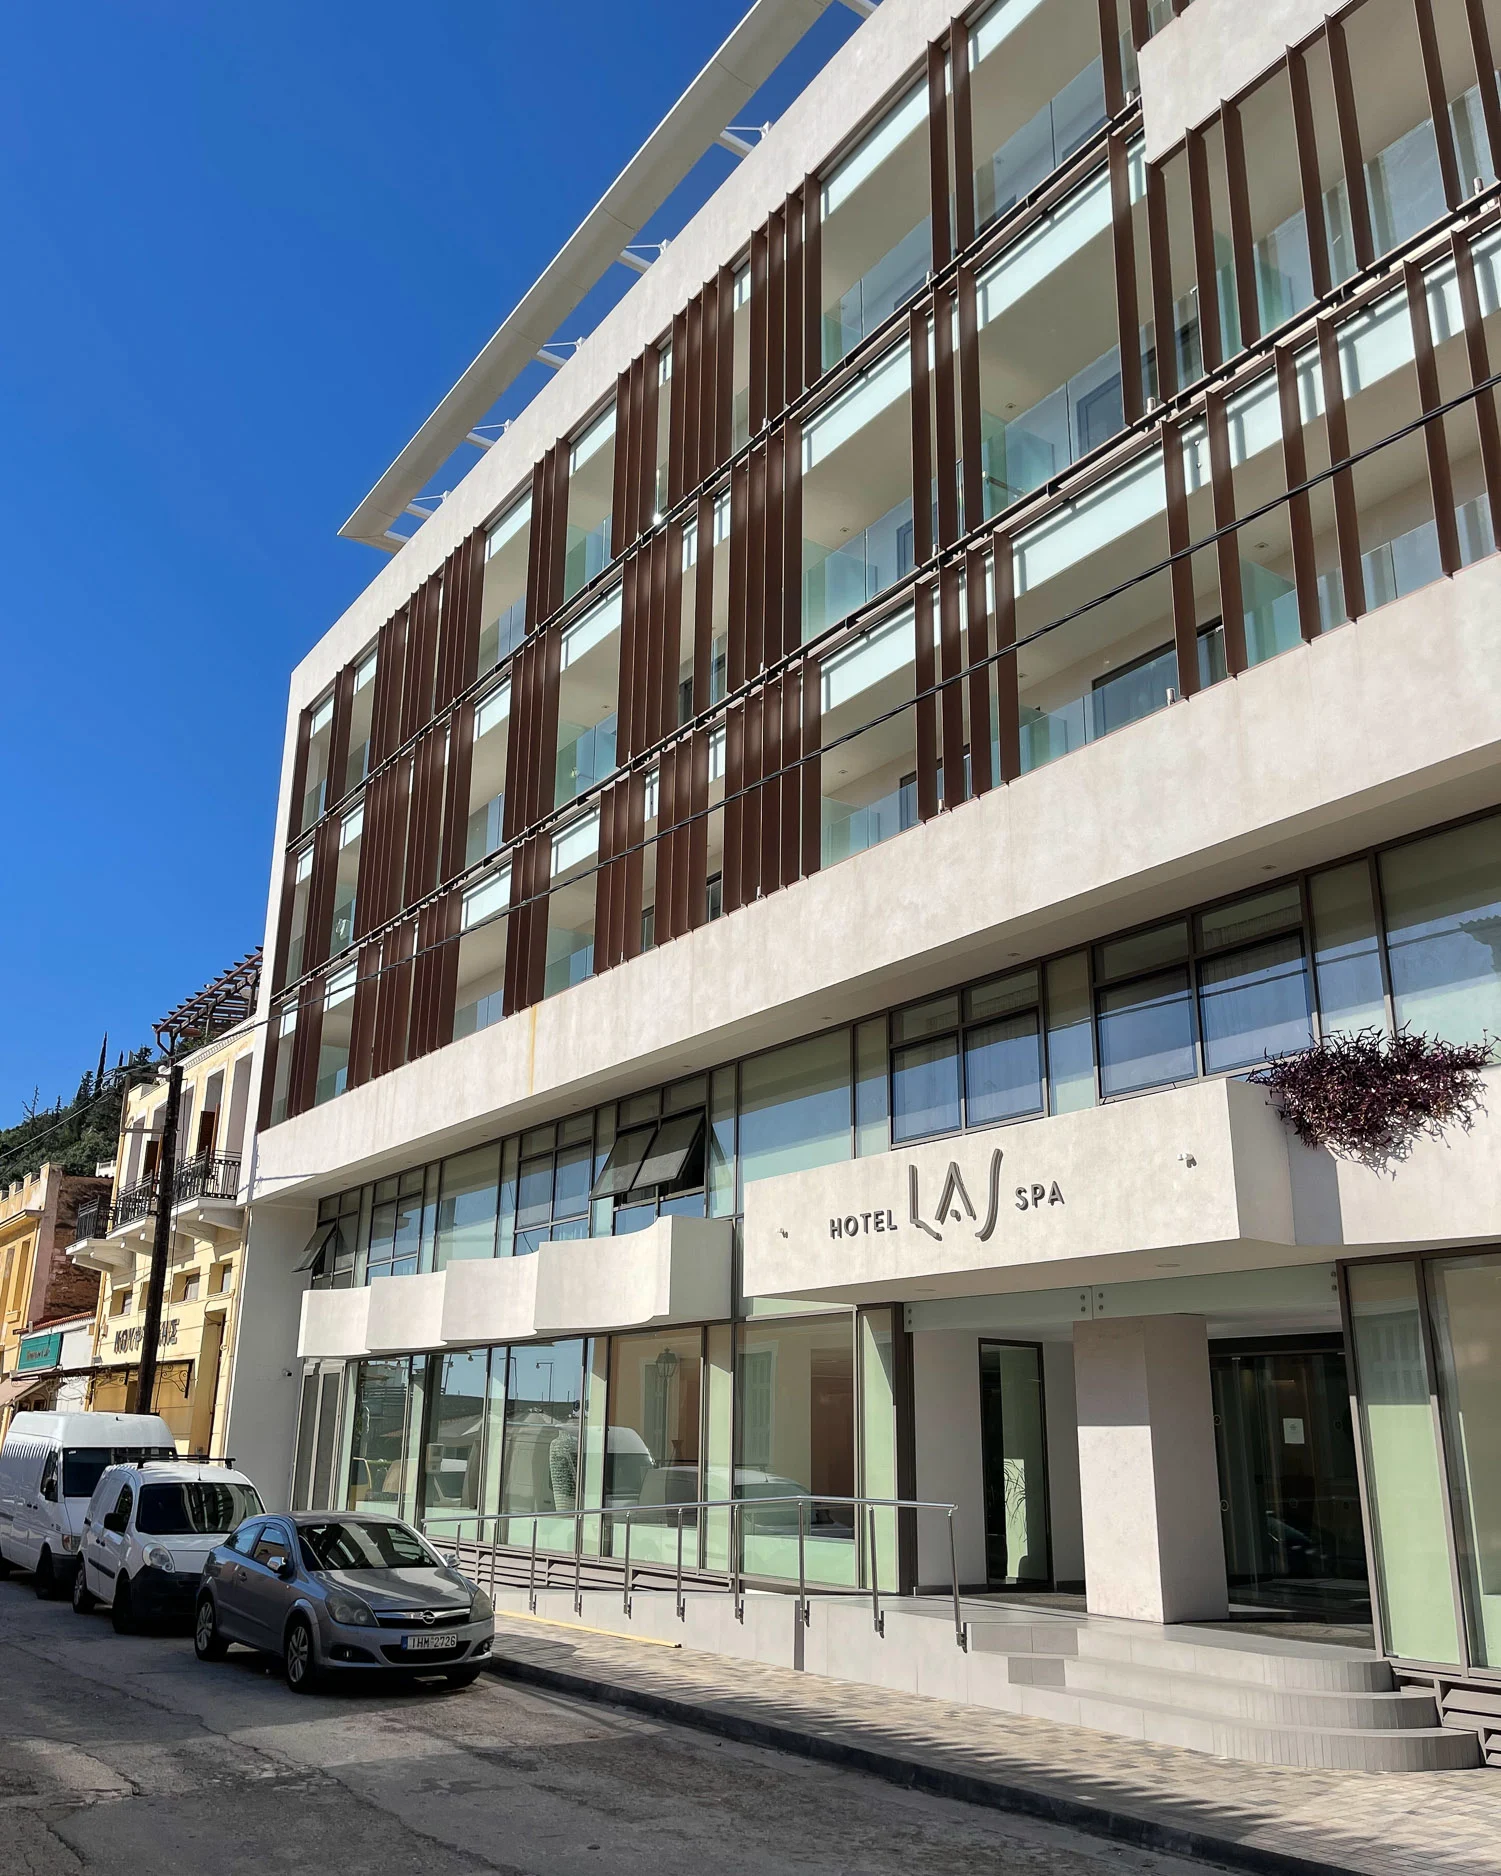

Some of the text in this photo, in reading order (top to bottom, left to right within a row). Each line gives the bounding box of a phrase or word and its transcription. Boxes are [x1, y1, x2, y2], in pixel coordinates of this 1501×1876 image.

[829, 1148, 1065, 1242] HOTEL LAJ SPA
